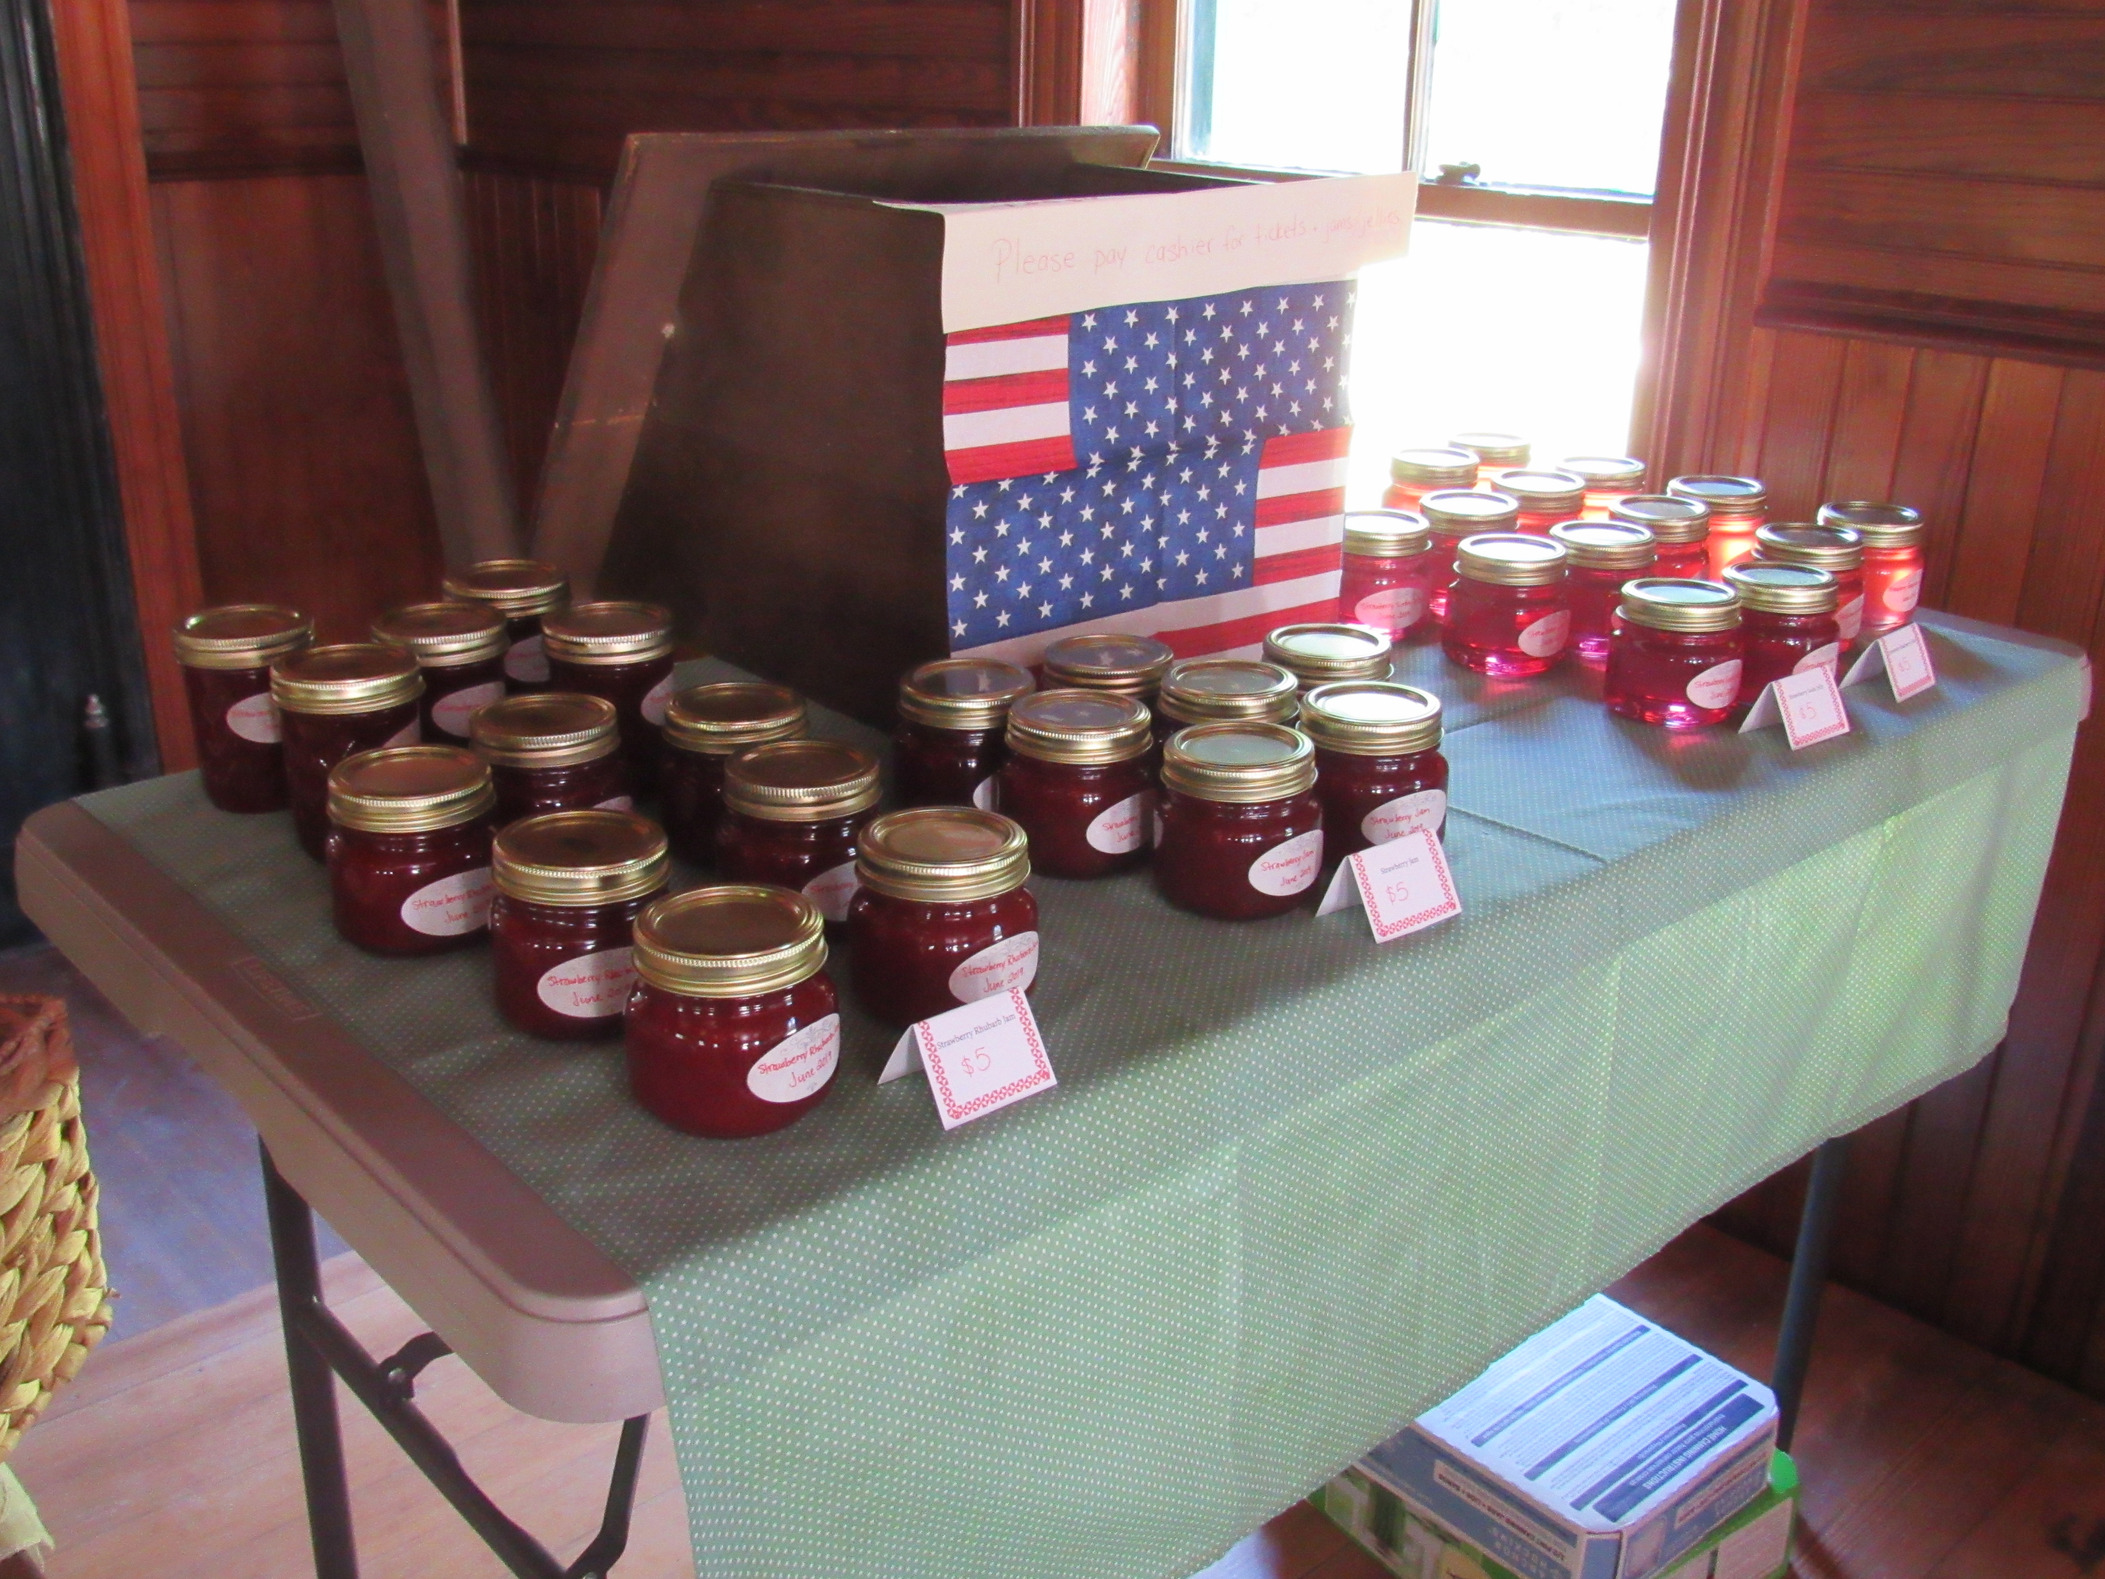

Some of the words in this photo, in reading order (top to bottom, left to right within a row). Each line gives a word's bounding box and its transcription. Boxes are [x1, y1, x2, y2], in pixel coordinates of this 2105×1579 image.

[991, 237, 1075, 284] Please
[1093, 245, 1127, 276] pay
[1145, 235, 1213, 264] cashier
[1222, 224, 1245, 250] for
[1255, 214, 1306, 244] tickets
[1370, 814, 1412, 826] Strawberry
[1414, 807, 1430, 818] Jam
[1384, 829, 1405, 840] June
[1261, 855, 1301, 871] Strawberry
[1380, 860, 1410, 875] Strawberry
[1280, 875, 1297, 887] June
[1386, 881, 1409, 906] $5
[961, 961, 1006, 978] Strawberry
[983, 977, 1004, 993] June
[572, 992, 603, 1006] June
[936, 1030, 974, 1050] Strawberry
[973, 1017, 1002, 1034] Rhubarb
[1002, 1013, 1017, 1025] Jam
[757, 1050, 809, 1075] Strawberry
[789, 1068, 815, 1088] June
[816, 1051, 832, 1071] 2019
[961, 1046, 991, 1078] $5
[1707, 1425, 1728, 1441] HOME
[1682, 1436, 1712, 1458] CANNING
[1641, 1454, 1685, 1490] INSTRUCTIONS
